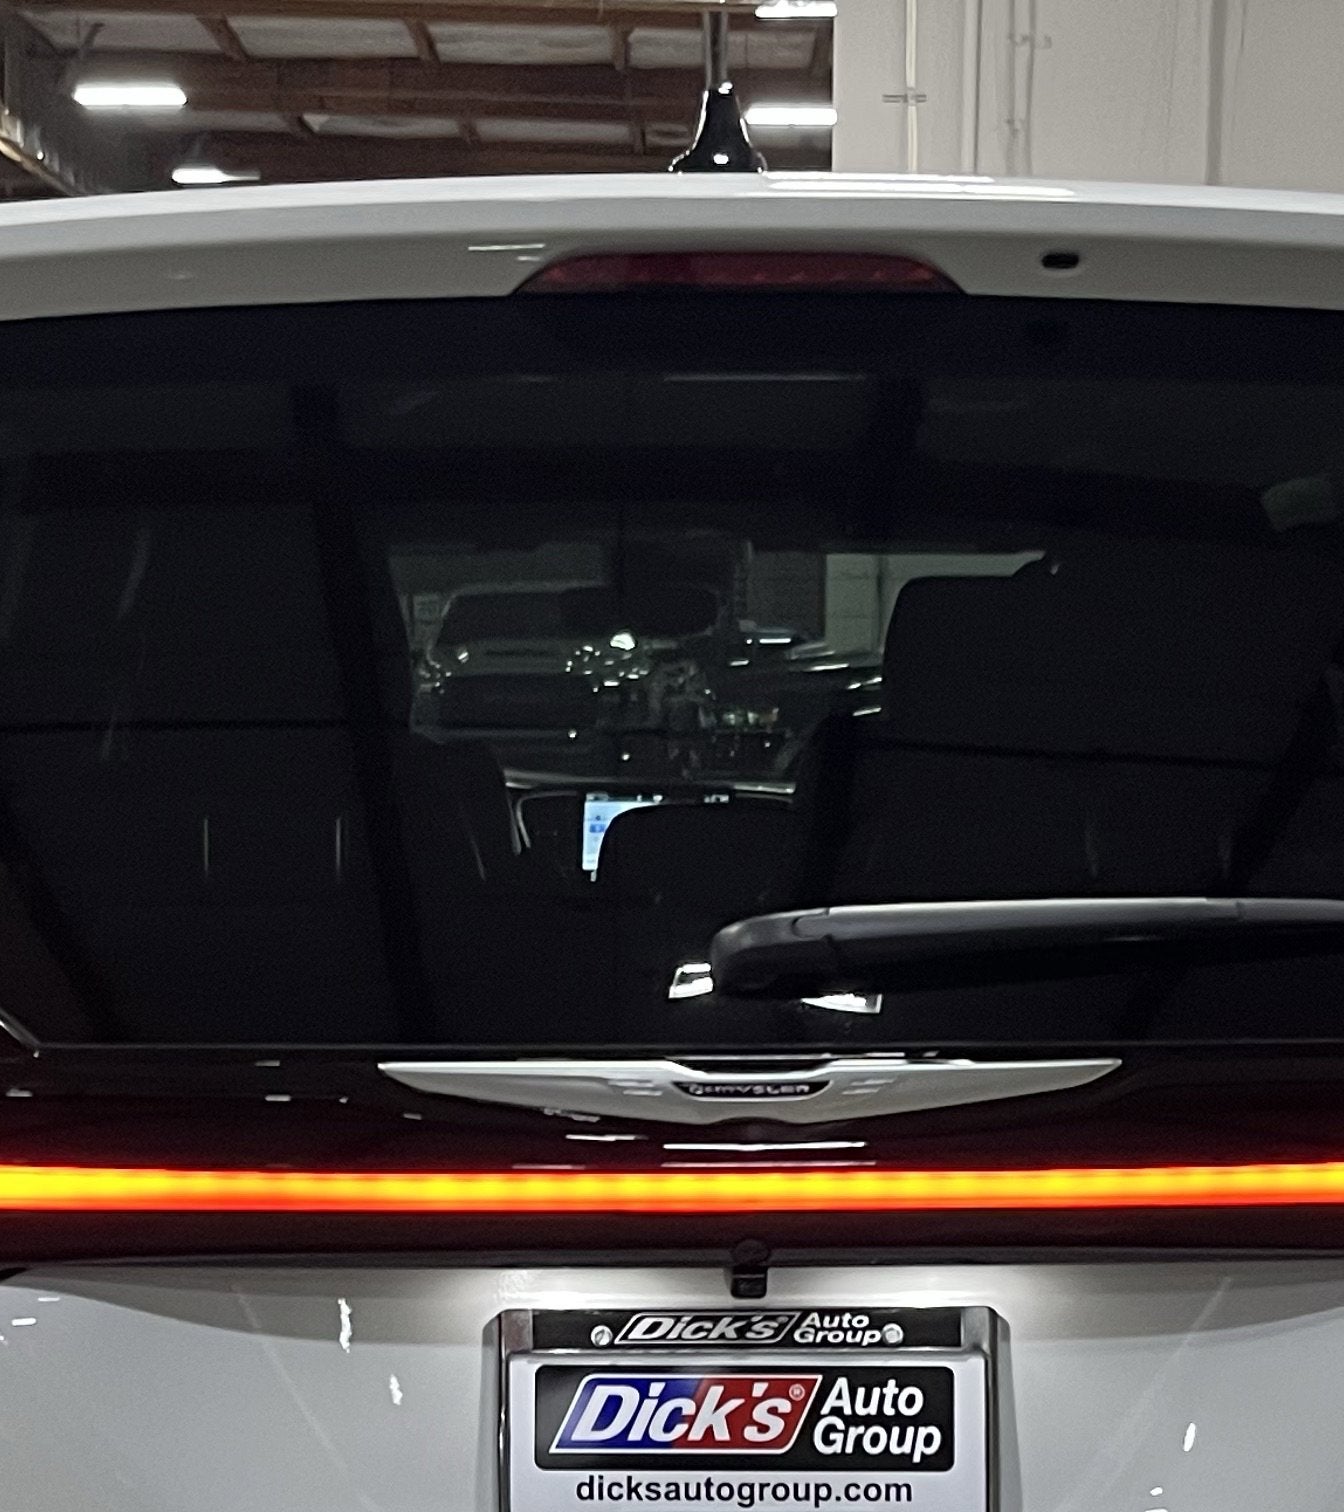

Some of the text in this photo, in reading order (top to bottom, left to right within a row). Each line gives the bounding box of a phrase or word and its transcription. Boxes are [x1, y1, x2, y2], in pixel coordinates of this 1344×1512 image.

[627, 1312, 870, 1340] Dick's Auto
[793, 1328, 882, 1346] Group
[571, 1377, 924, 1442] Dick's Auto
[812, 1417, 942, 1463] Group
[575, 1475, 913, 1507] dicksautogroup.com
